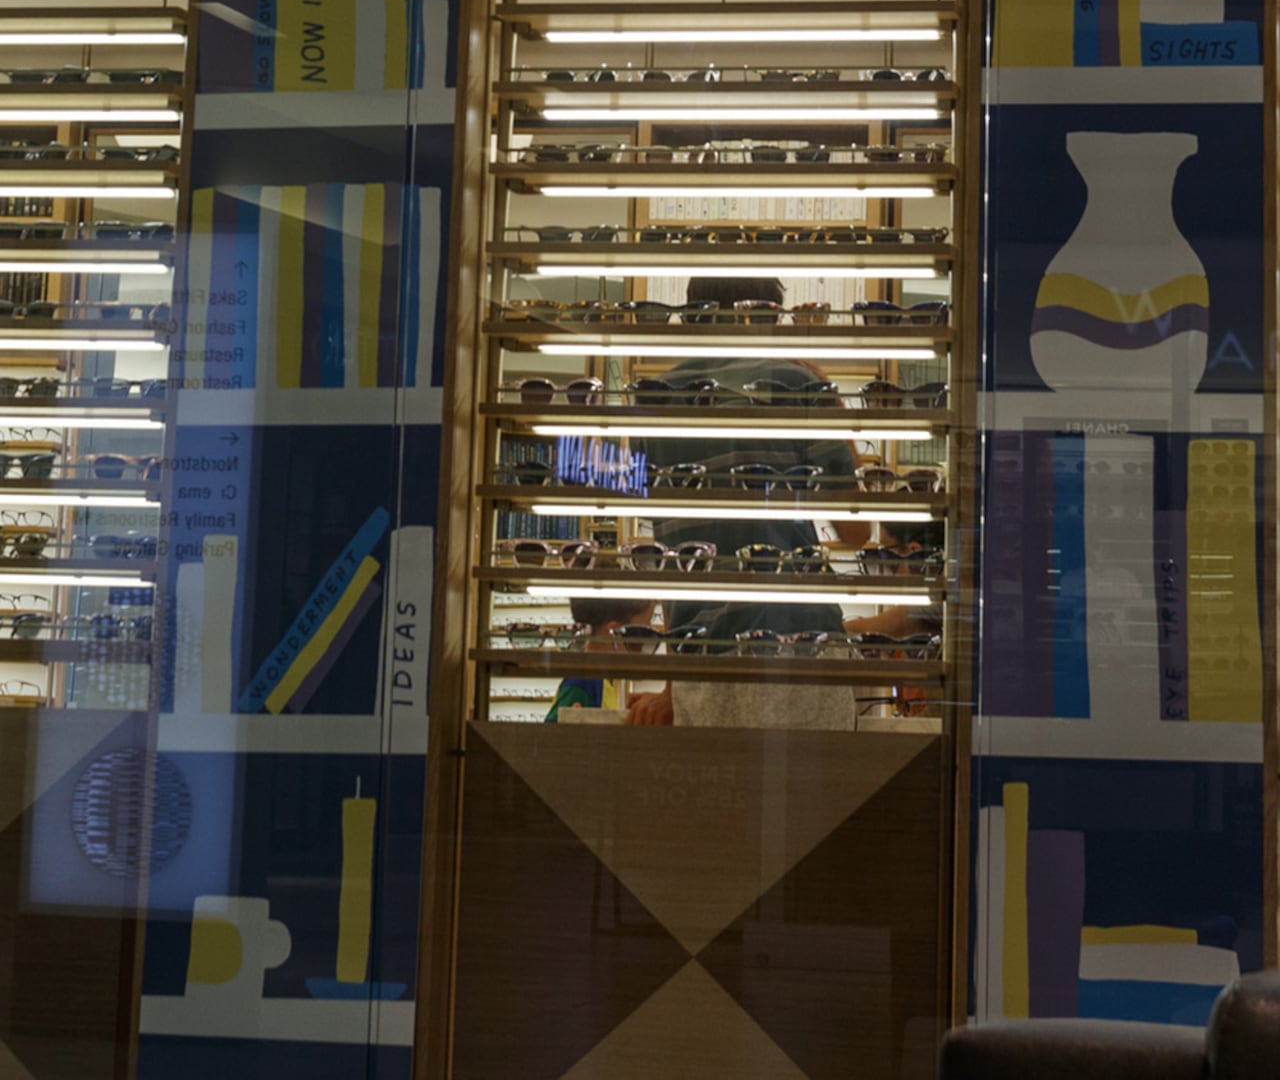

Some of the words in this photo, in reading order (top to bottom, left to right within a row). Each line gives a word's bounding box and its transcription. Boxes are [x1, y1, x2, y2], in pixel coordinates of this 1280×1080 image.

[300, 22, 327, 84] NOW
[1150, 39, 1238, 61] SIGHTS
[251, 552, 358, 699] WONDERMENT
[392, 601, 416, 706] IDEAS
[1166, 667, 1184, 718] EYE
